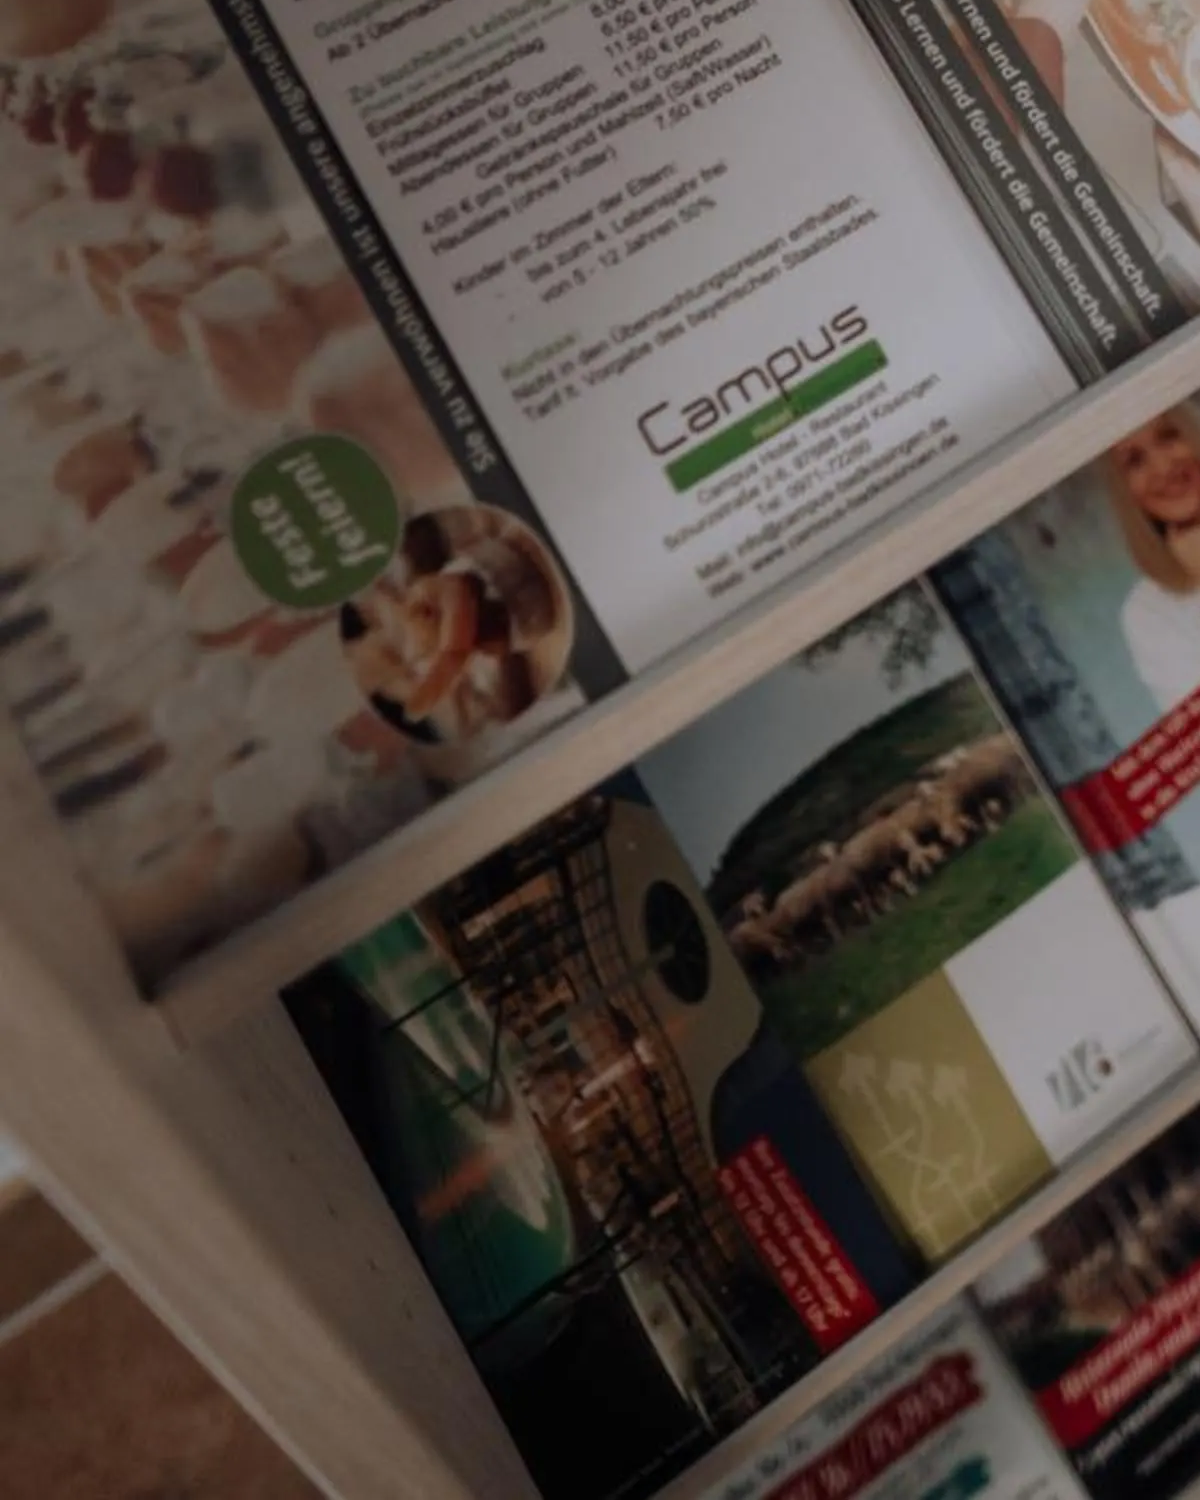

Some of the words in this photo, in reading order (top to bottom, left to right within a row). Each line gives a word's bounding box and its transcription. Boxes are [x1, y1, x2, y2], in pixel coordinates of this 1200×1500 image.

[499, 118, 525, 140] für
[526, 80, 599, 127] Gruppen
[671, 24, 702, 49] pro
[511, 62, 586, 110] Gruppen
[662, 5, 692, 31] pro
[628, 74, 653, 95] für
[651, 36, 724, 83] Gruppen
[473, 182, 505, 209] pro
[502, 149, 565, 189] Person
[563, 128, 598, 157] und
[510, 176, 562, 214] (ohne
[704, 79, 735, 105] pro
[732, 51, 783, 86] Nacht
[897, 0, 950, 70] Lernen
[939, 68, 976, 110] und
[963, 107, 1017, 179] fördert
[1005, 177, 1036, 212] die
[1025, 209, 1121, 348] Gemeinschaft.
[304, 136, 363, 224] unsere
[984, 39, 1021, 82] und
[1009, 78, 1062, 150] fördert
[1051, 147, 1081, 182] die
[1070, 179, 1164, 317] Gemeinschaft.
[347, 221, 382, 260] ist
[451, 256, 507, 296] Kinder
[532, 207, 595, 251] Zimmer
[595, 189, 625, 215] der
[539, 277, 573, 304] von
[621, 215, 679, 257] Jahren
[367, 256, 457, 398] verwöhnen
[575, 338, 610, 366] den
[653, 320, 686, 346] des
[445, 394, 475, 429] zu
[635, 303, 871, 457] Campus
[461, 428, 498, 474] Sie
[246, 495, 330, 585] Feste
[275, 450, 390, 564] feiern!
